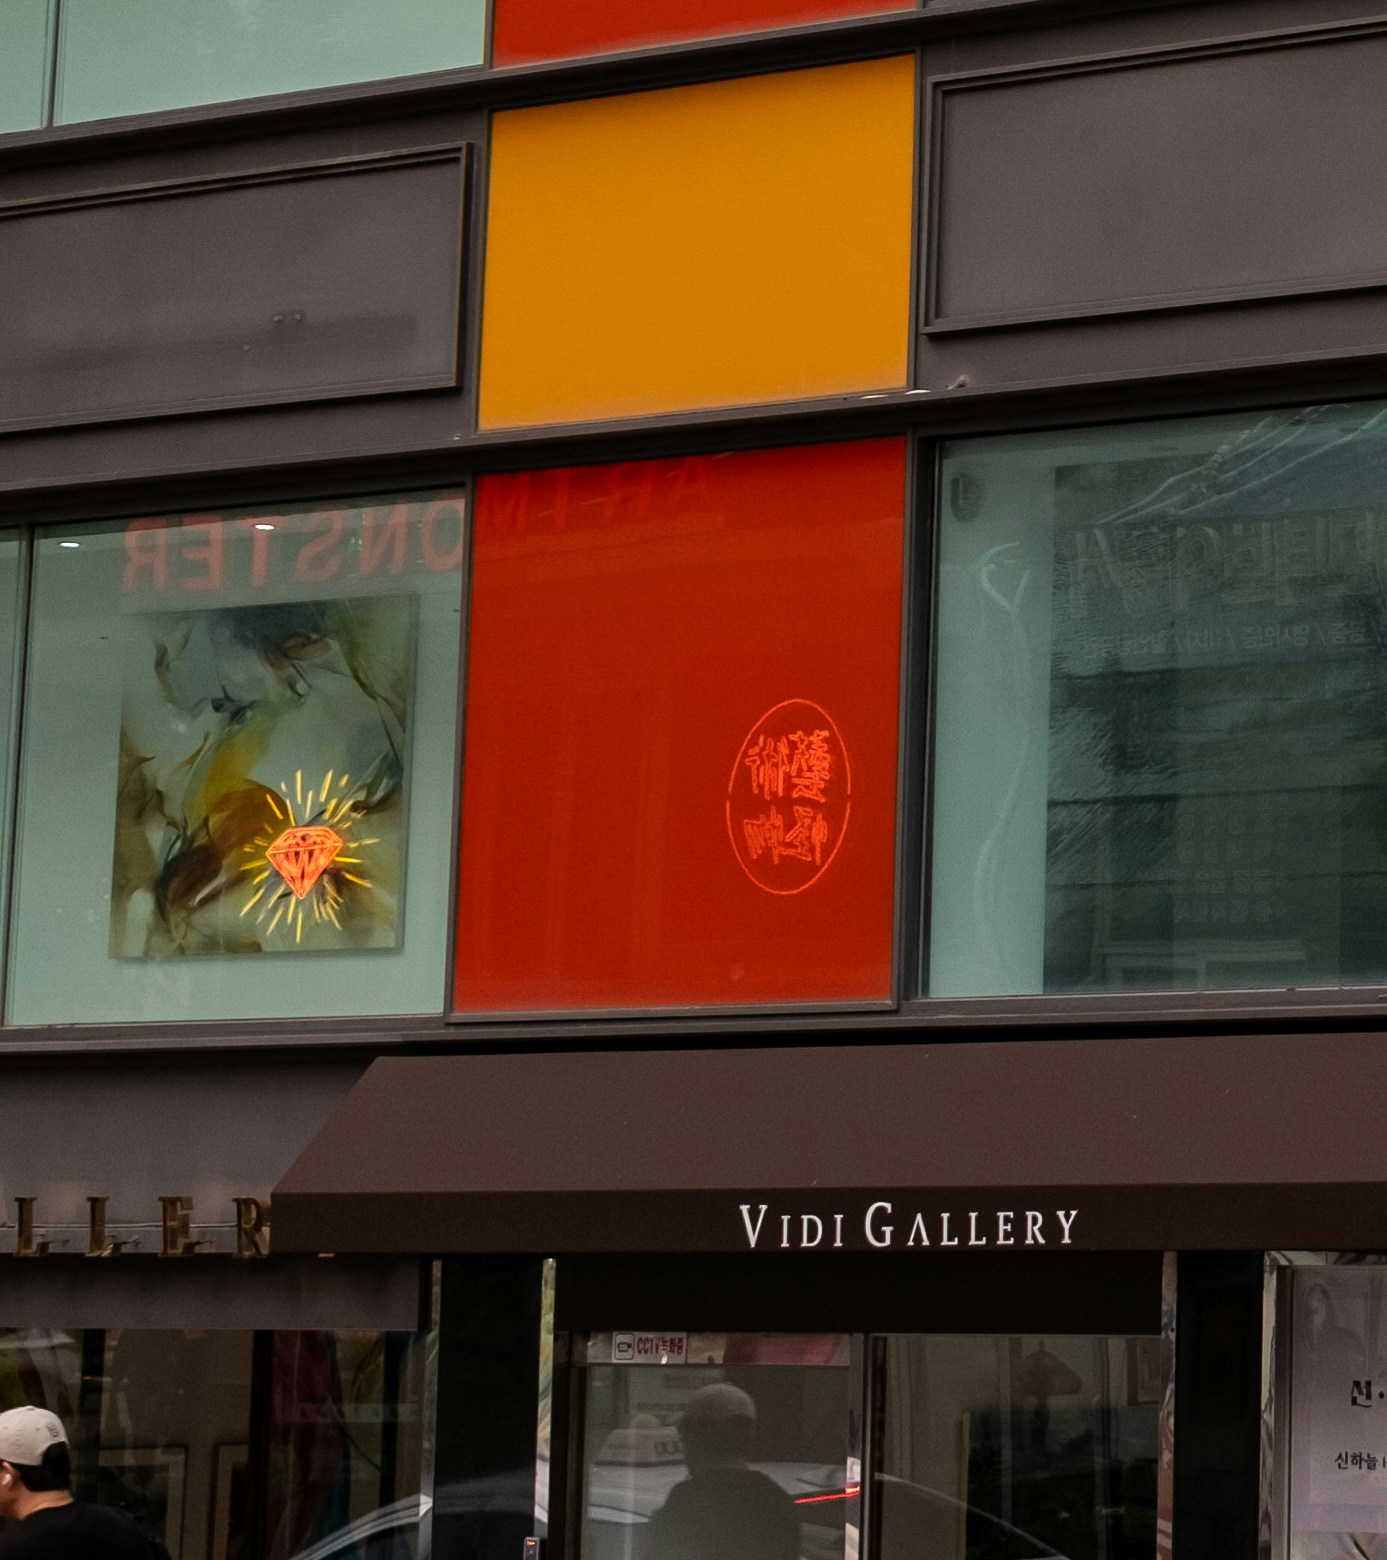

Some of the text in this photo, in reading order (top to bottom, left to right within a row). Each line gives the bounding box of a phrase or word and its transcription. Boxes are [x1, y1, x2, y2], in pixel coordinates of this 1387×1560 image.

[13, 1196, 334, 1259] LLER
[739, 1201, 1079, 1248] VIDI GALLERY
